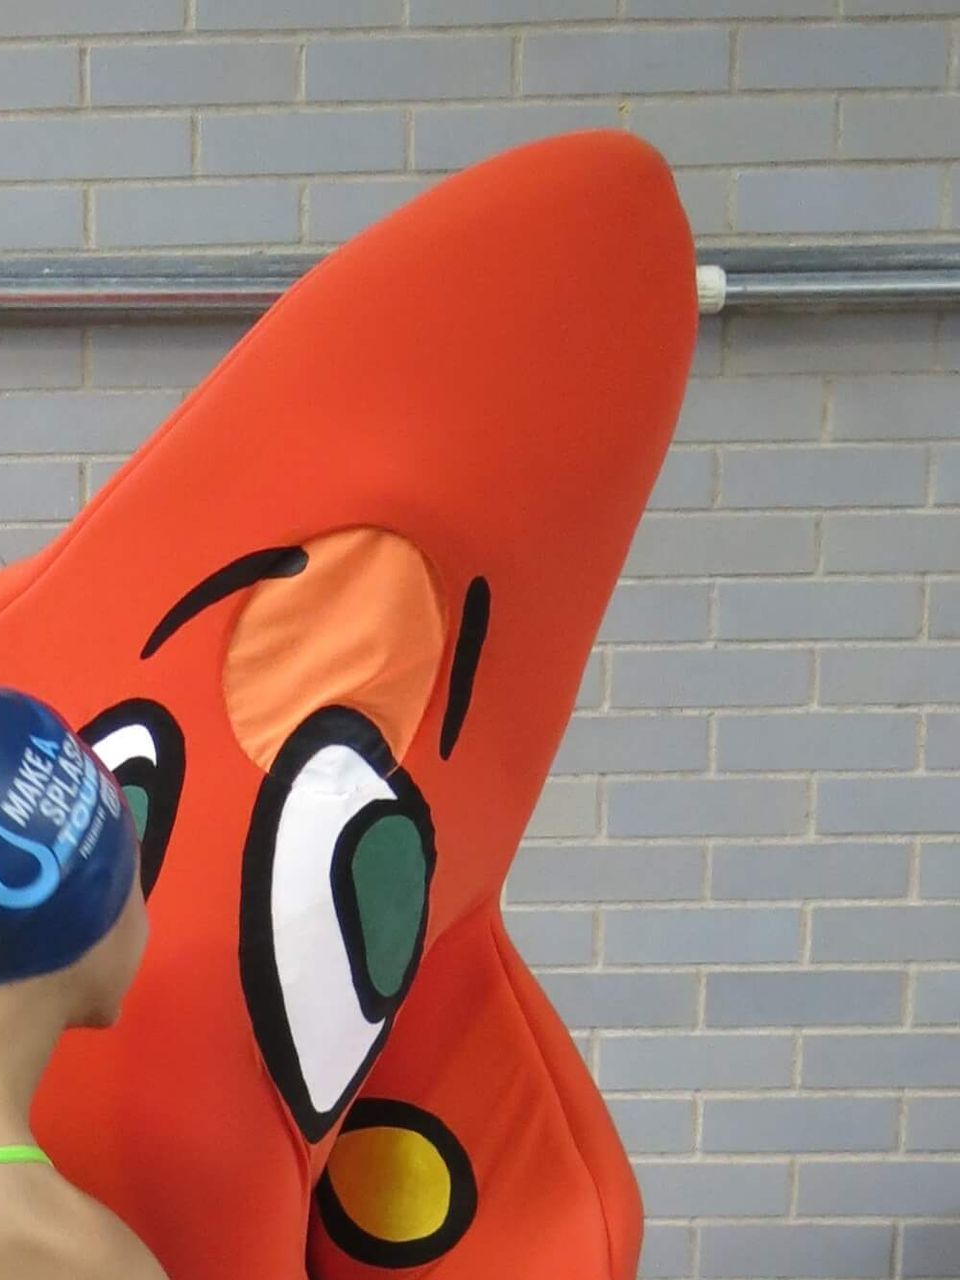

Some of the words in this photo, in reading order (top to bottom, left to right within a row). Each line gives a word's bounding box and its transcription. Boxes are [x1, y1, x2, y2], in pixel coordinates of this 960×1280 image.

[0, 747, 54, 828] MAKE
[29, 735, 60, 760] A
[39, 731, 86, 827] SPLAS
